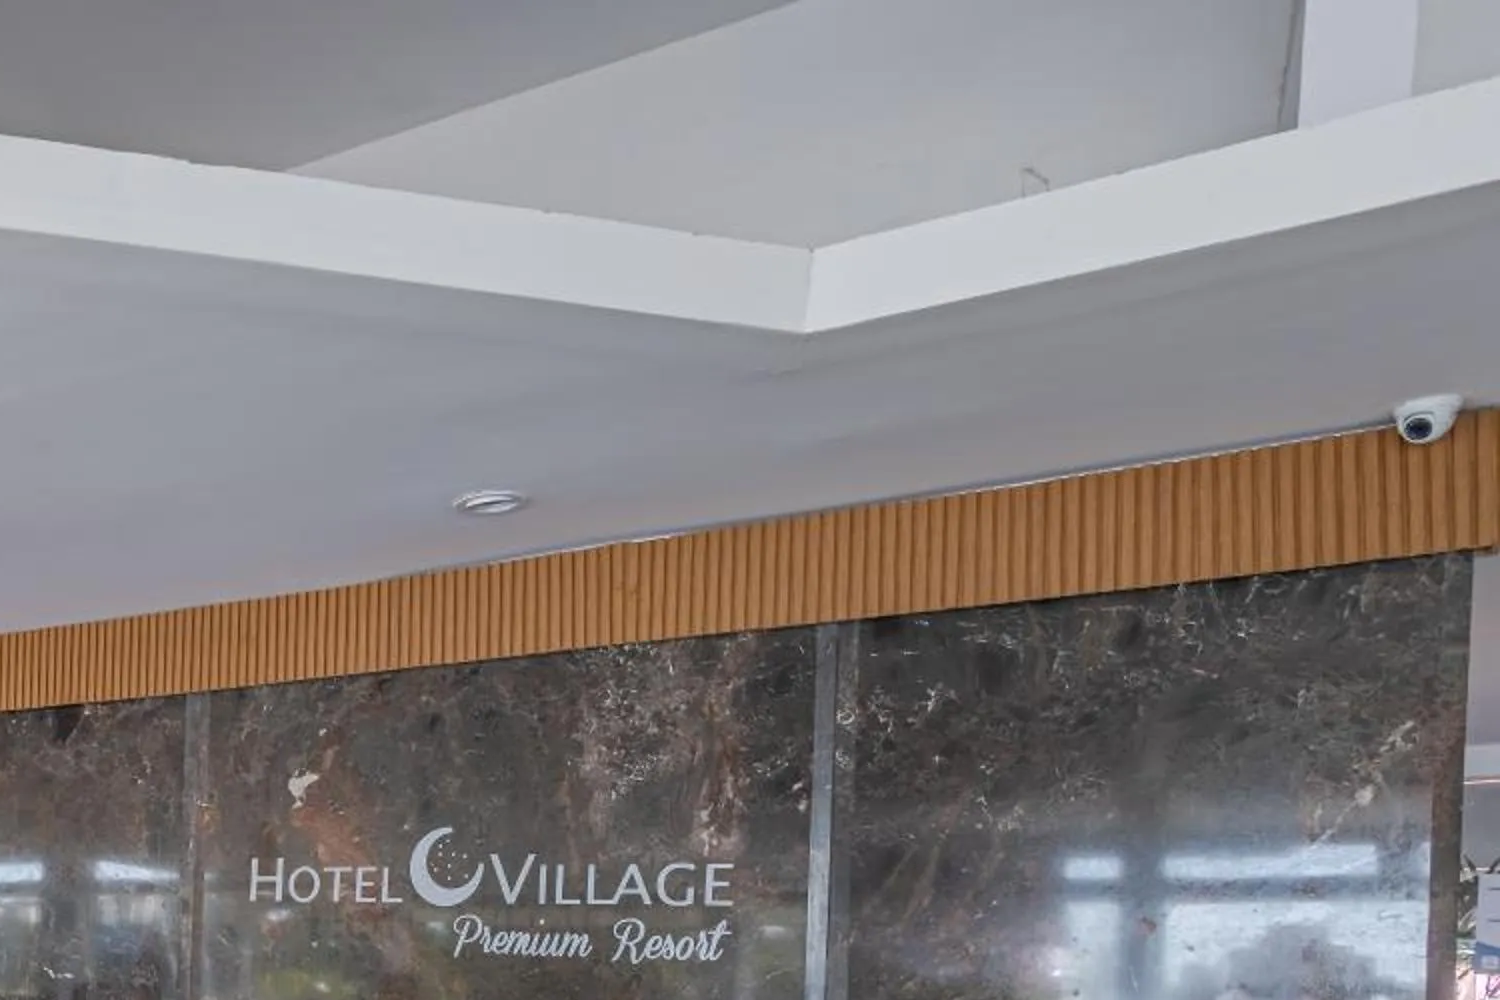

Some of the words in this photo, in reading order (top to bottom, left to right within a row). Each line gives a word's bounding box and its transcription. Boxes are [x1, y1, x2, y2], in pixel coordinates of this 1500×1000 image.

[249, 857, 403, 903] HOTEL
[489, 853, 735, 907] VILLAGE
[453, 914, 593, 958] Premium
[611, 917, 733, 965] Resort
